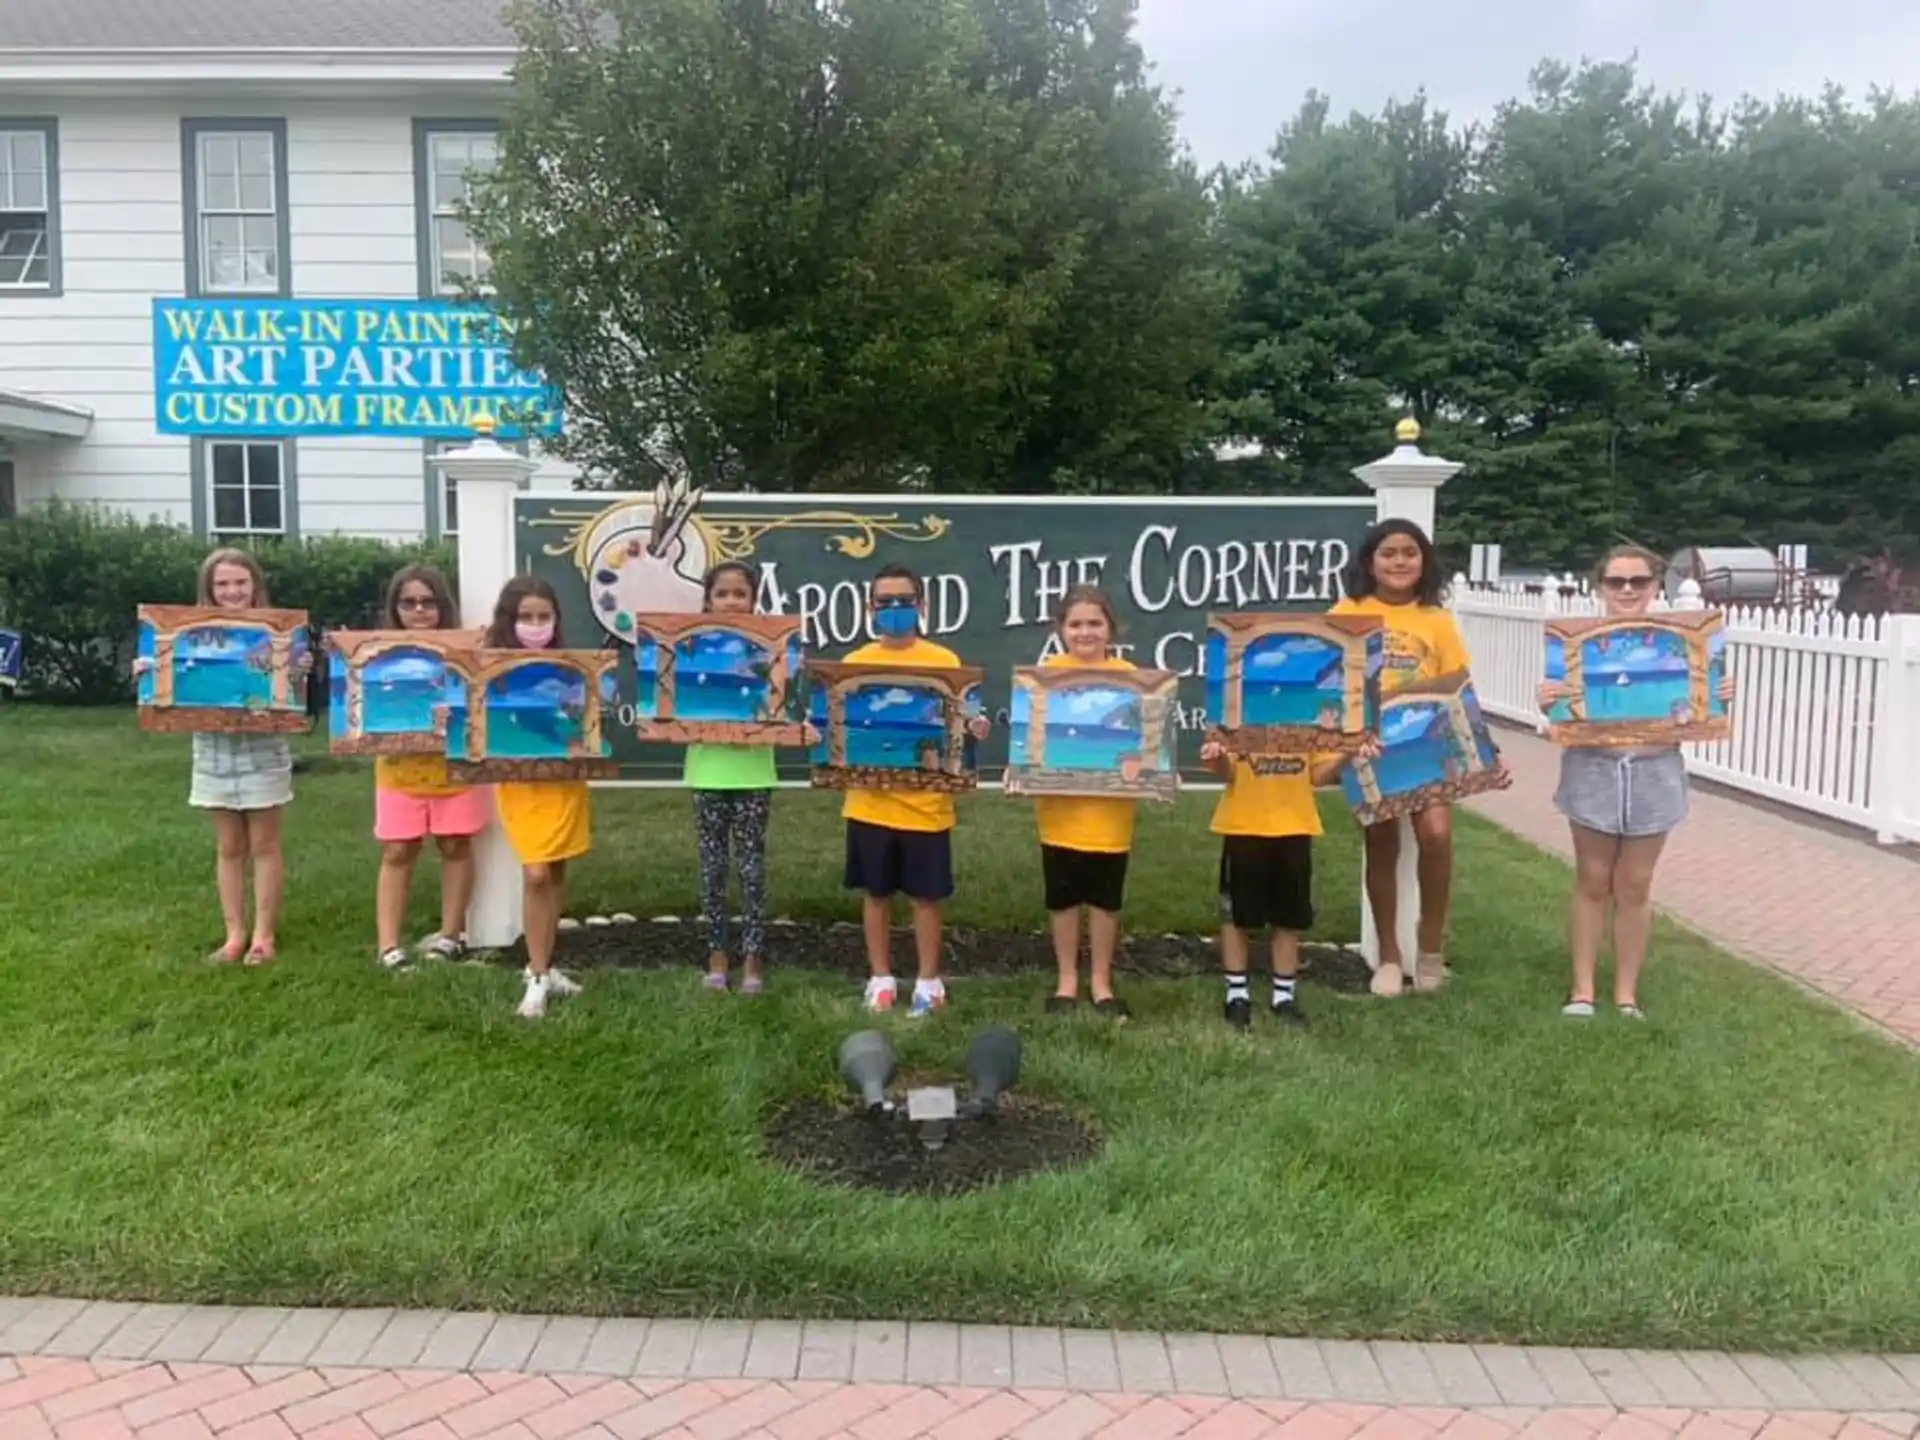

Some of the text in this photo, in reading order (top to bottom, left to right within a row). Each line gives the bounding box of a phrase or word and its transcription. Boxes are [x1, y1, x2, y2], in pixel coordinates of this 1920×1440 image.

[163, 309, 343, 342] WALK-IN
[167, 344, 288, 386] ART
[165, 391, 342, 425] CUSTOM
[1129, 525, 1349, 612] CORNER
